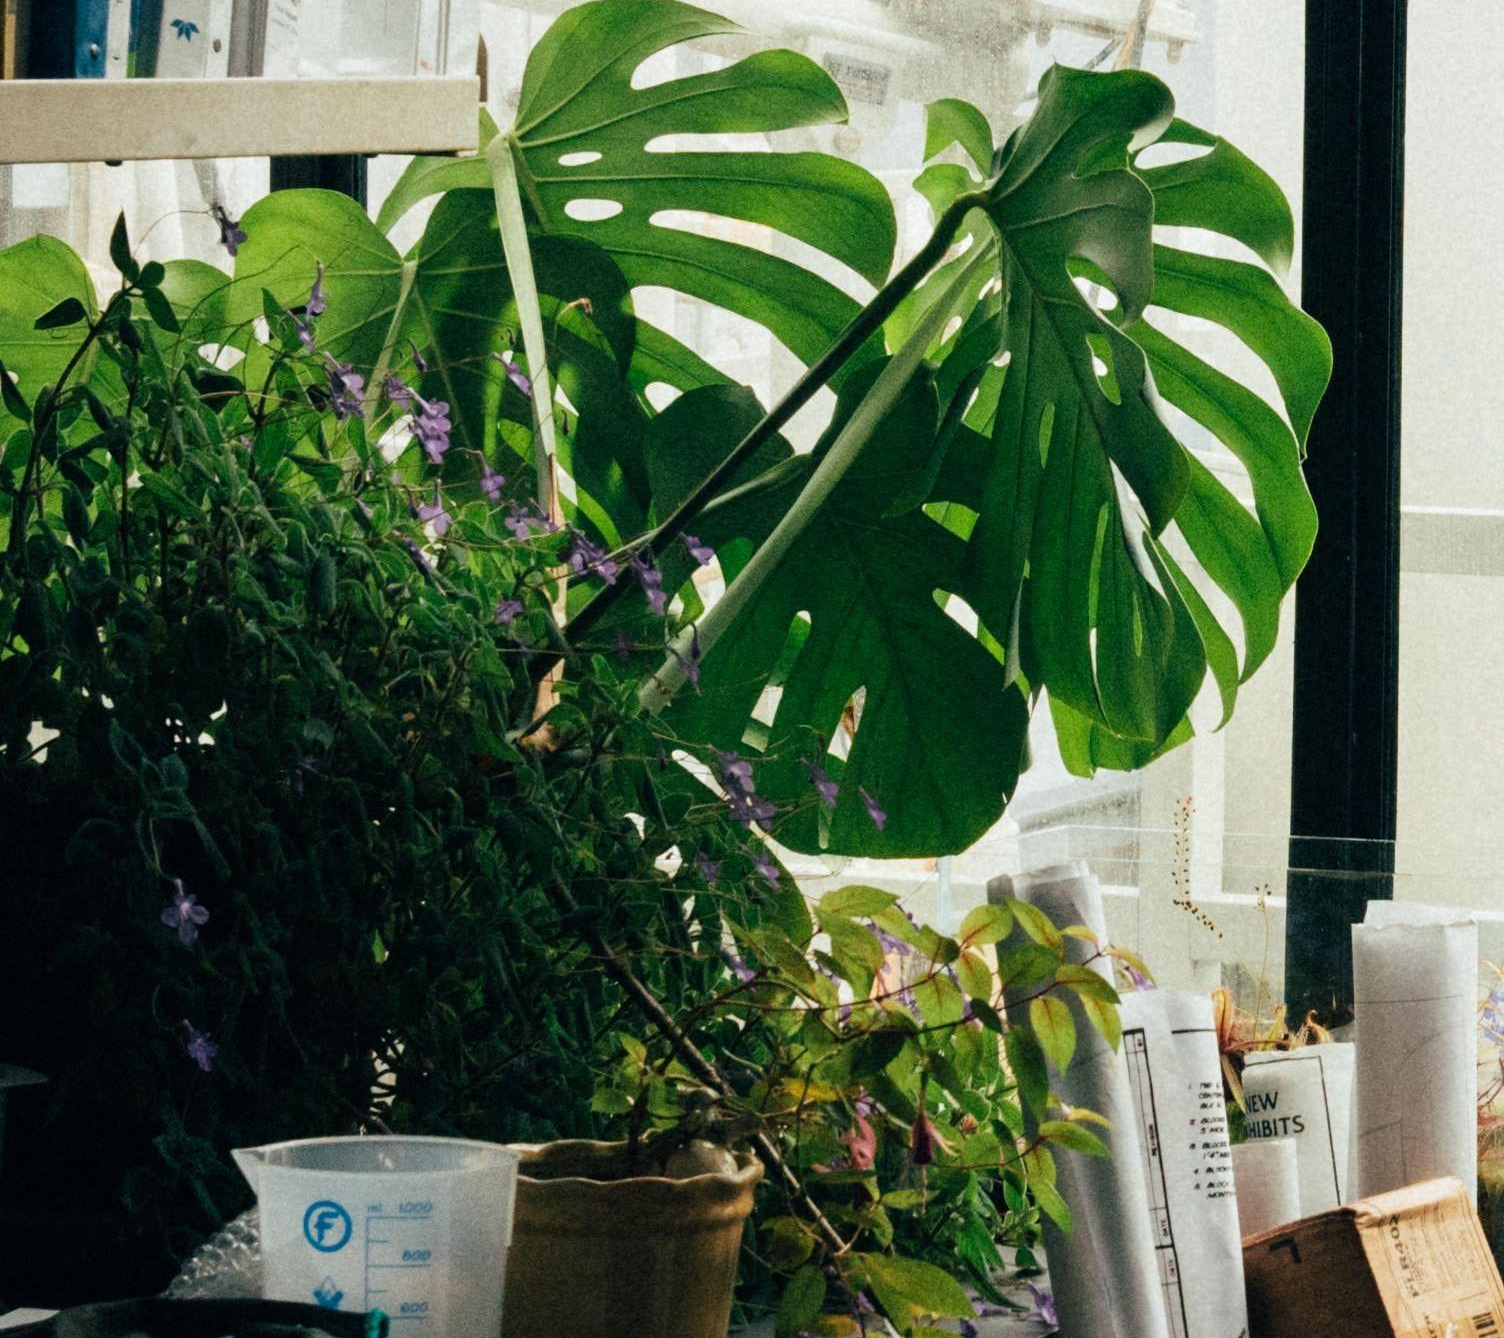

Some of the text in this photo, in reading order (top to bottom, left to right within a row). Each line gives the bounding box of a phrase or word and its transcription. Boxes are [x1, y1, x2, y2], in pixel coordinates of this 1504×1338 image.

[1244, 1090, 1279, 1114] NEW
[1246, 1114, 1305, 1138] HIBITS
[398, 1201, 433, 1213] 1000
[399, 1301, 429, 1312] 600
